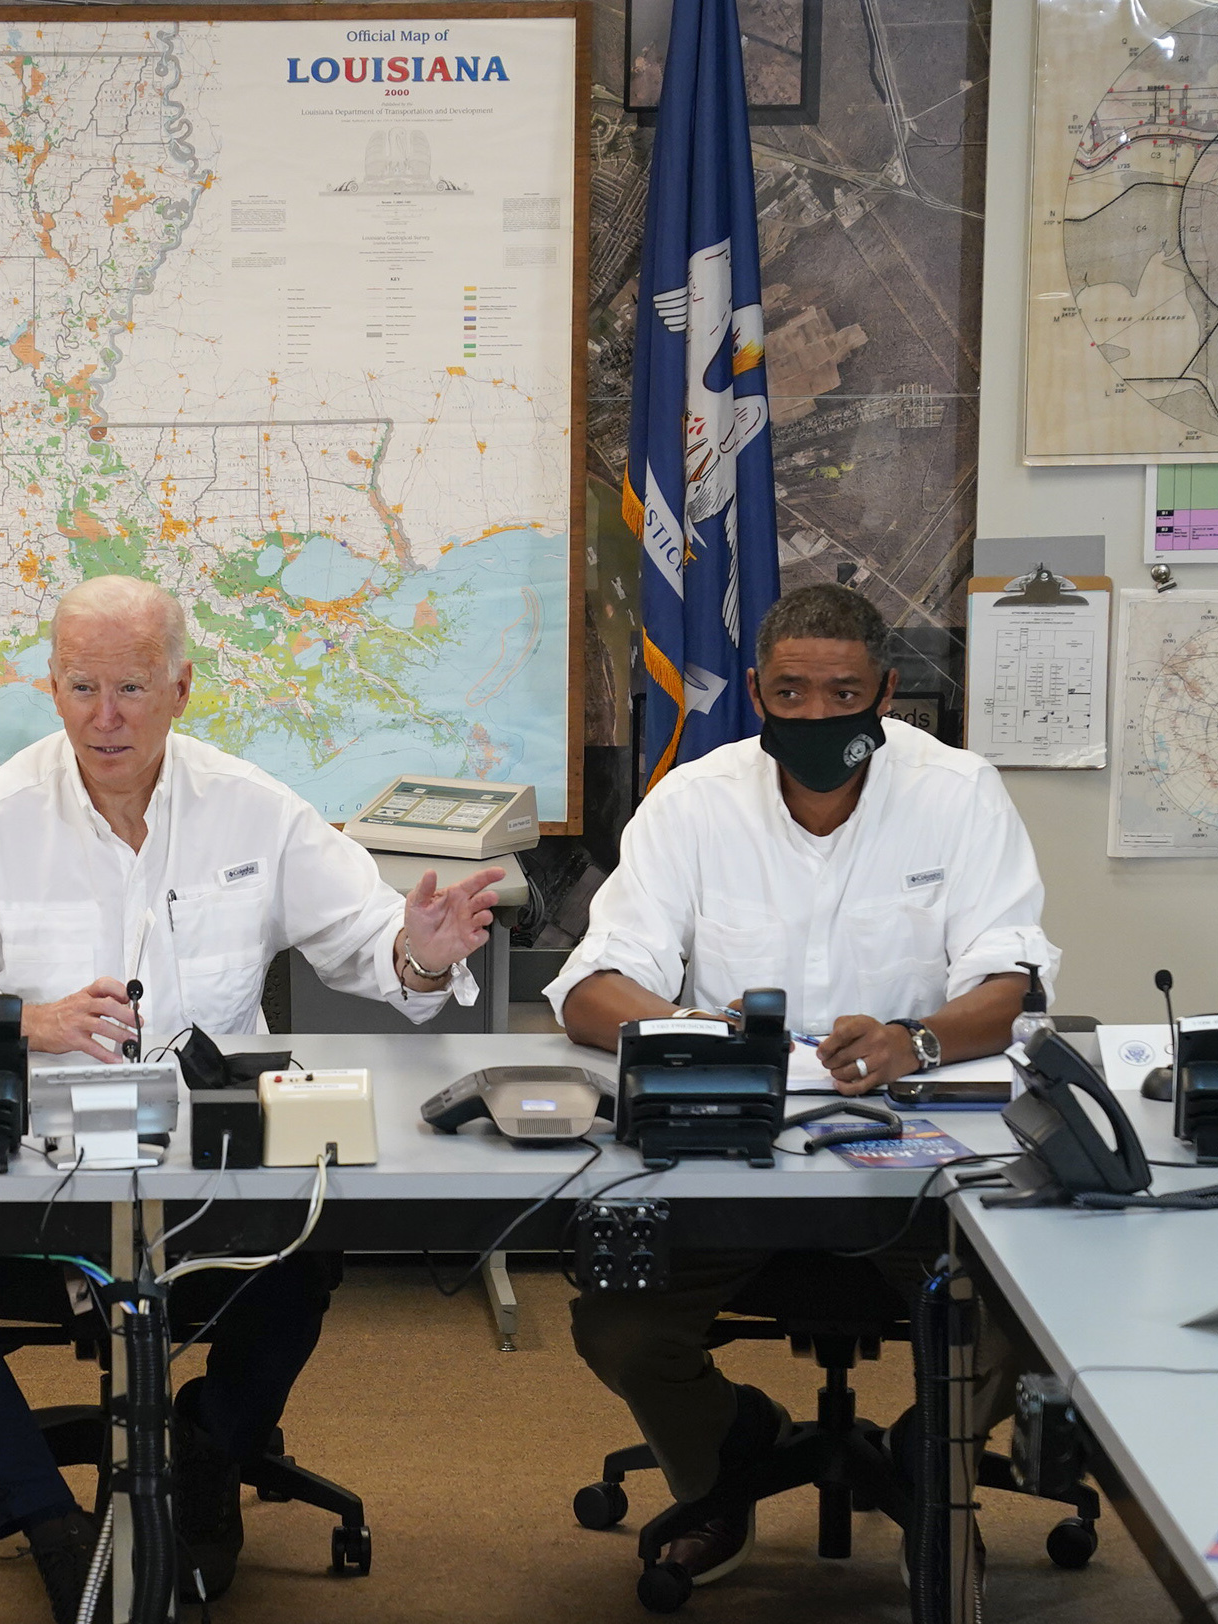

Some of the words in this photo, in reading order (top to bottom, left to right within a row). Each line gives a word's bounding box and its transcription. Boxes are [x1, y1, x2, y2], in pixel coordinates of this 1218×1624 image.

[346, 29, 396, 42] Official
[400, 30, 432, 45] Map
[434, 29, 449, 42] of
[286, 55, 511, 84] LOUISIANA
[384, 88, 410, 97] 2000
[301, 108, 333, 116] Louisiana
[334, 108, 375, 117] Department
[384, 107, 433, 117] Transportation
[449, 107, 494, 117] Development
[1136, 225, 1147, 233] C4
[1189, 225, 1201, 233] C2
